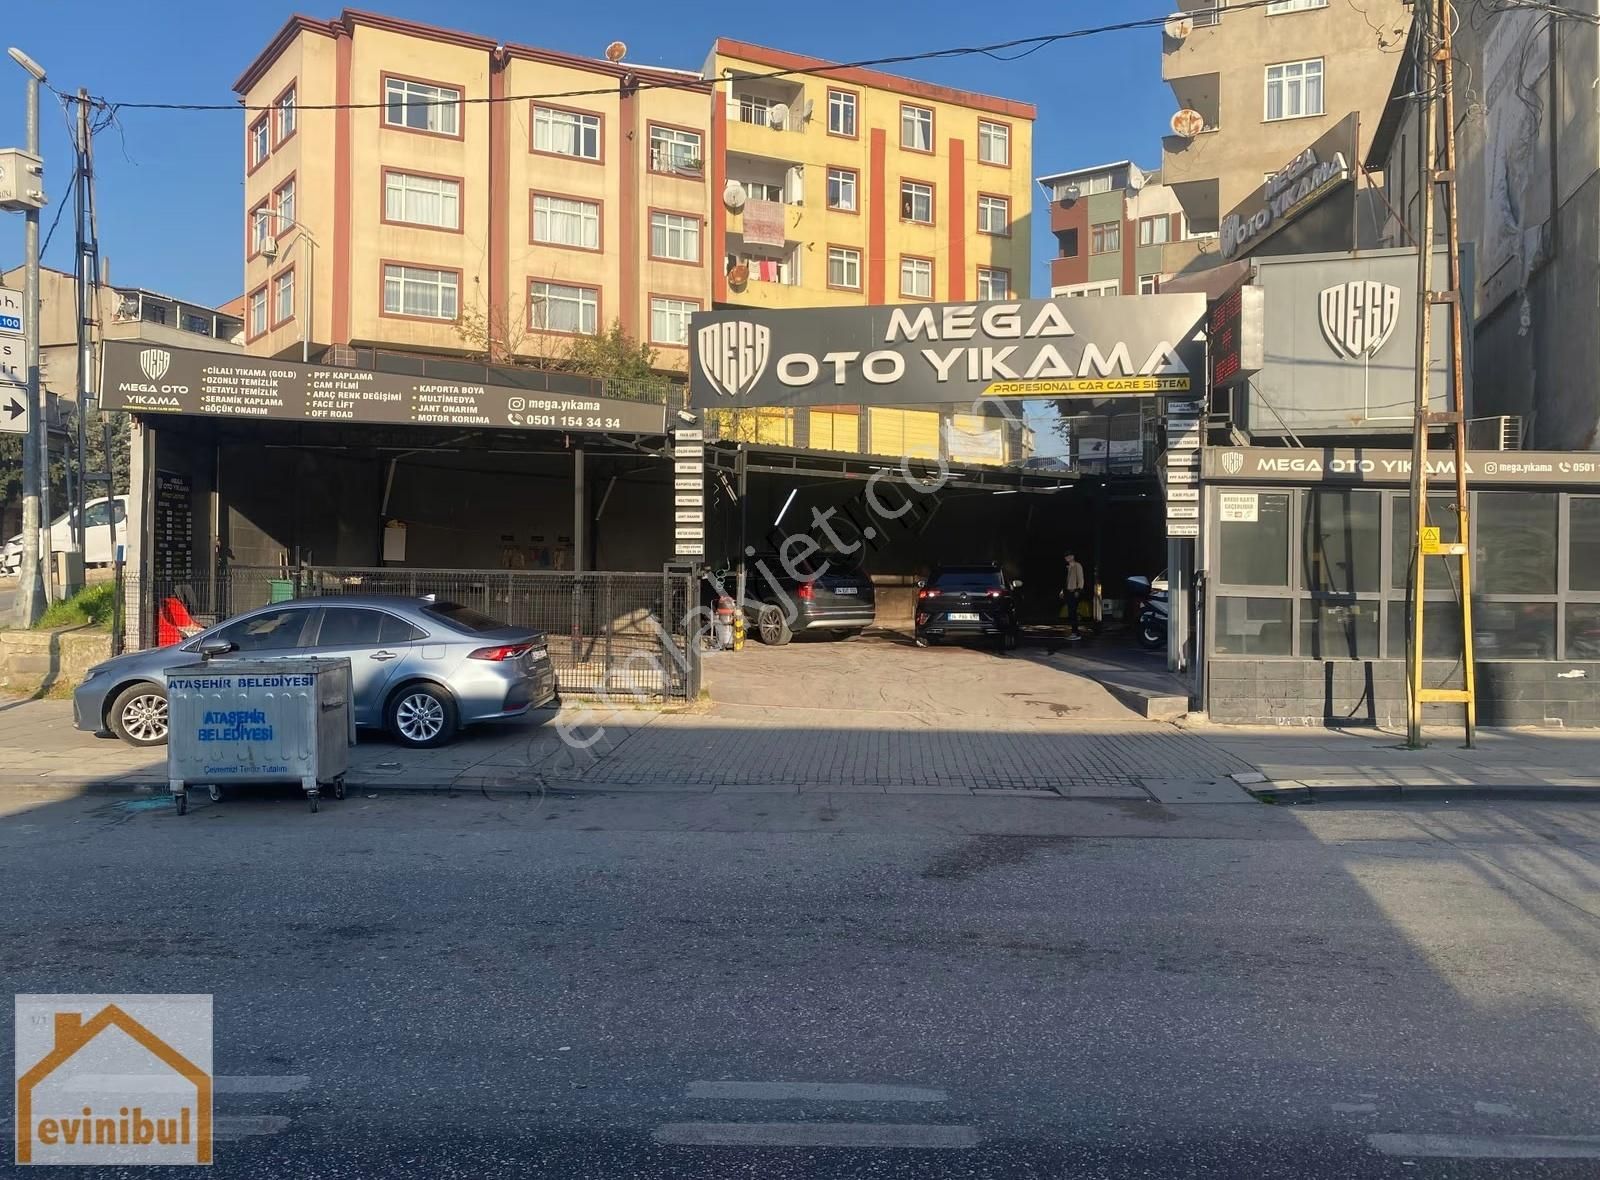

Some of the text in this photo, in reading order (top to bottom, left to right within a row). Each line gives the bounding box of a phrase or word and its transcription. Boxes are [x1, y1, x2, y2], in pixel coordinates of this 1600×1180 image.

[884, 303, 1075, 342] MEGA
[1318, 280, 1401, 360] MEGA
[698, 320, 771, 396] MEGA
[776, 350, 906, 387] OTO
[920, 340, 1190, 382] YIKAMA
[140, 349, 171, 381] MEGA
[207, 366, 297, 380] CİLALI YIKAMA (GOLD)
[314, 371, 374, 381] PPF KAPLAMA
[206, 376, 279, 388] OZONLU TEMİZLİK
[313, 380, 359, 390] CAM FİLMİ
[994, 379, 1188, 393] PROFESIONAL CAR CARE SISTEM
[119, 383, 189, 395] MEGA OTO
[206, 385, 279, 397] DETAYLI TEMİZLİK
[313, 390, 336, 400] ARAÇ
[337, 391, 360, 400] RENK
[419, 385, 484, 395] KAPORTA BOYA
[126, 394, 180, 406] YIKAMA
[205, 394, 283, 407] SERAMİK KAPLAMA
[312, 400, 354, 409] FACE LİFT
[419, 393, 475, 404] MULTİMEDYA
[235, 406, 268, 416] ONARIM
[311, 409, 353, 418] OFF ROAD
[418, 405, 478, 415] JANT ONARIM
[418, 414, 490, 425] MOTOR KORUMA
[526, 415, 620, 429] 0501 154 34 34
[1257, 458, 1323, 472] MEGA
[1329, 459, 1375, 473] OTO
[1573, 462, 1595, 472] 0501
[169, 675, 313, 689] ATAŞEHİR BELEDİYESİ
[198, 725, 273, 741] BELEDİYESİ
